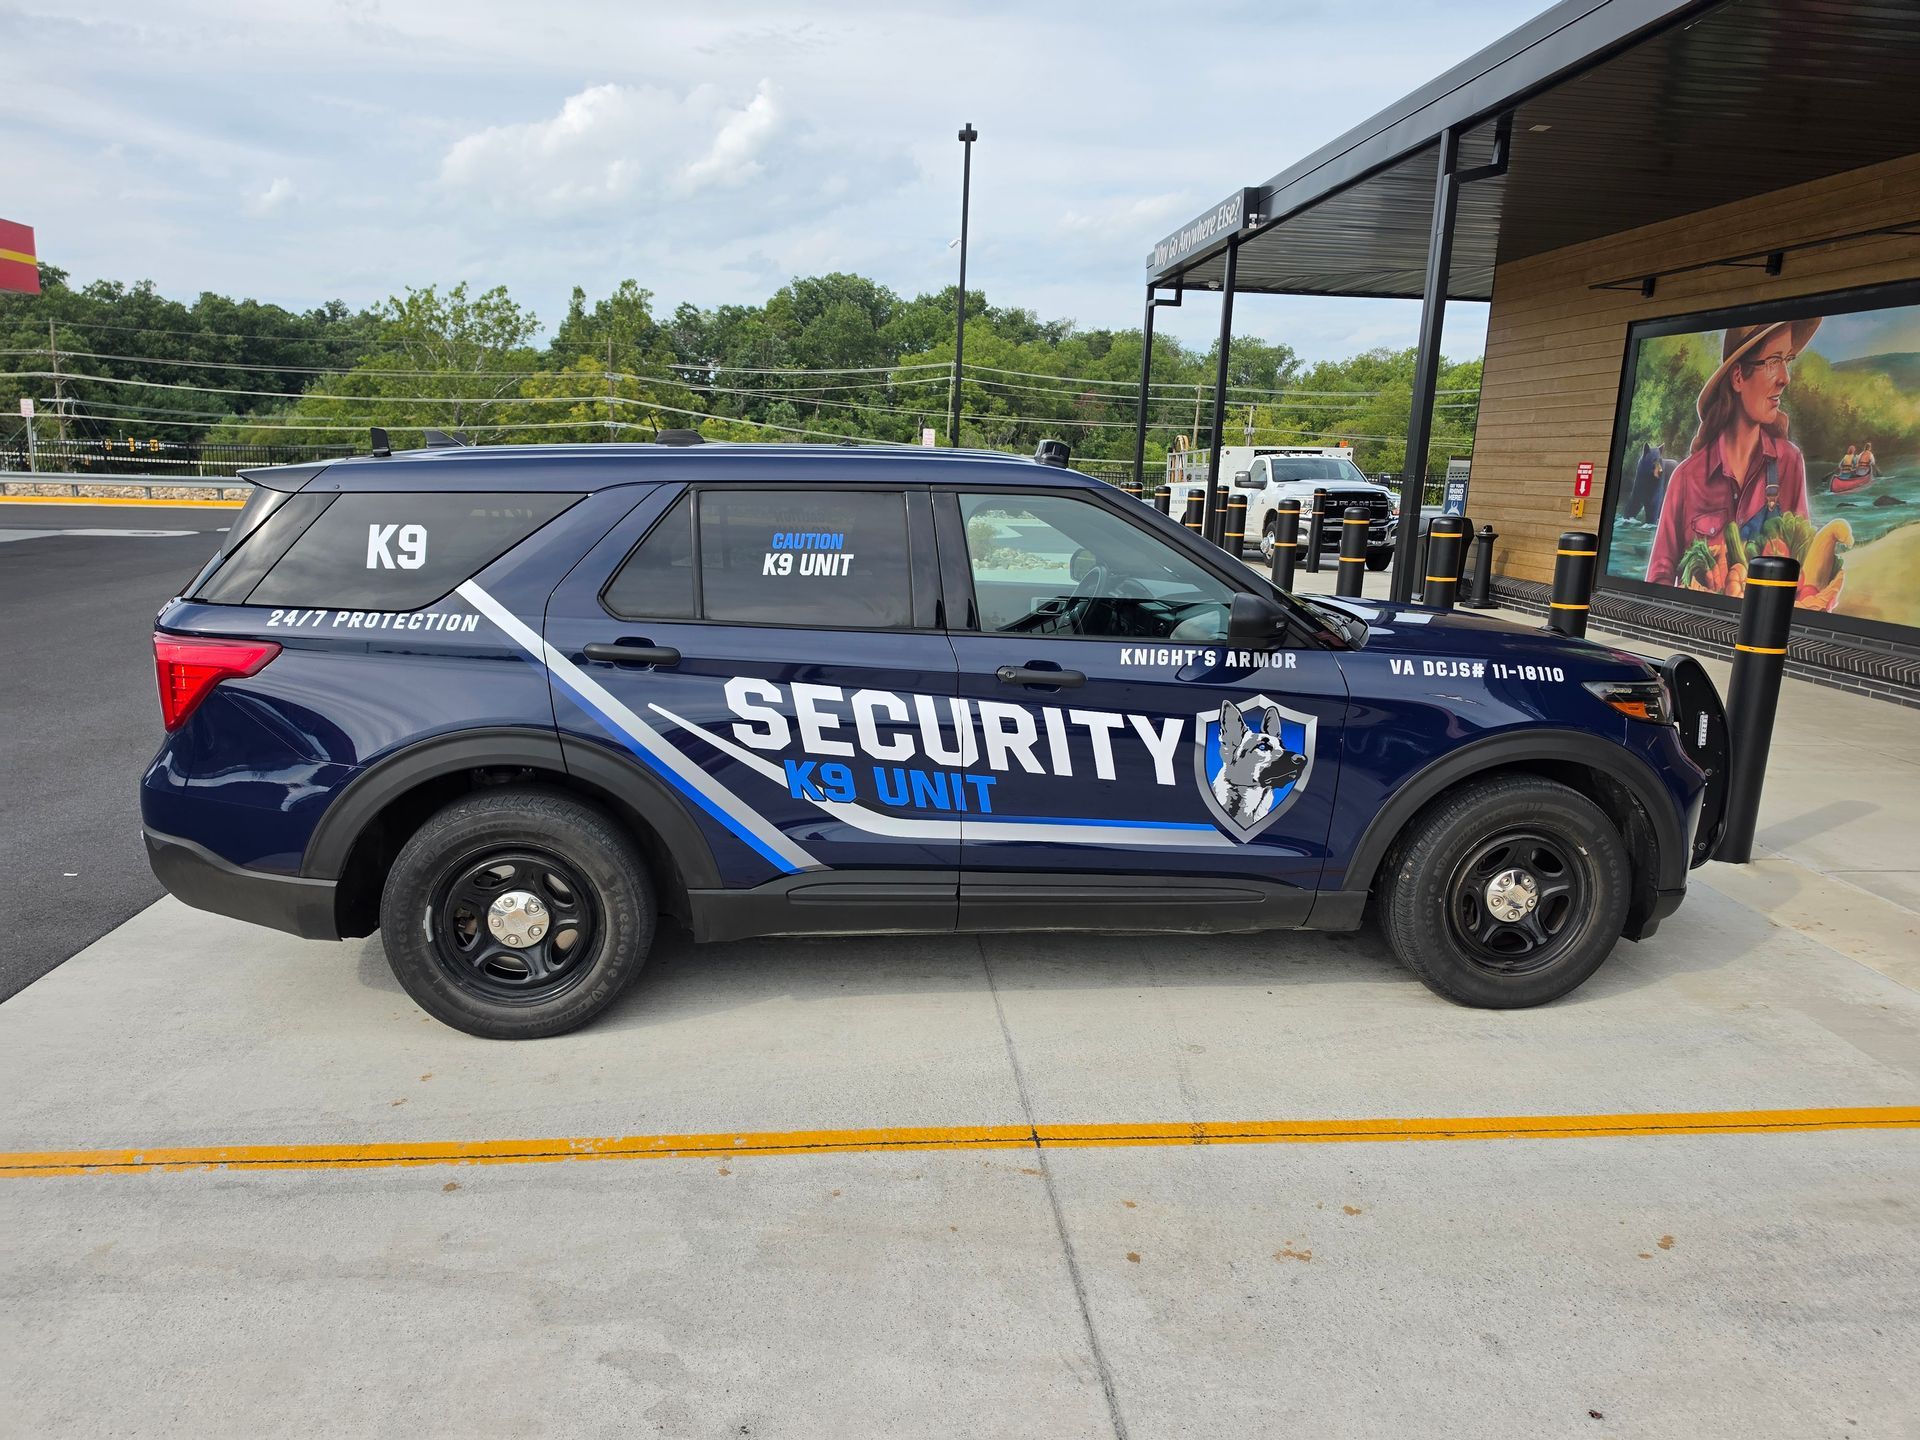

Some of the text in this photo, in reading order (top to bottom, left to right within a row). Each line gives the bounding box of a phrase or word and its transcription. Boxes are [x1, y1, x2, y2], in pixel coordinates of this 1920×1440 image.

[1154, 196, 1241, 267] Why Go Anywhere Else?
[366, 524, 427, 570] K9
[772, 532, 844, 550] CAUTION
[762, 553, 854, 576] K9 UNIT
[266, 609, 480, 632] 24/7 PROTECTION
[1120, 648, 1297, 669] KNIGHT'S ARMOR
[1390, 659, 1565, 683] VA DCJS# 11-18110
[724, 676, 1185, 786] SECURITY
[784, 759, 997, 813] K9 UNIT
